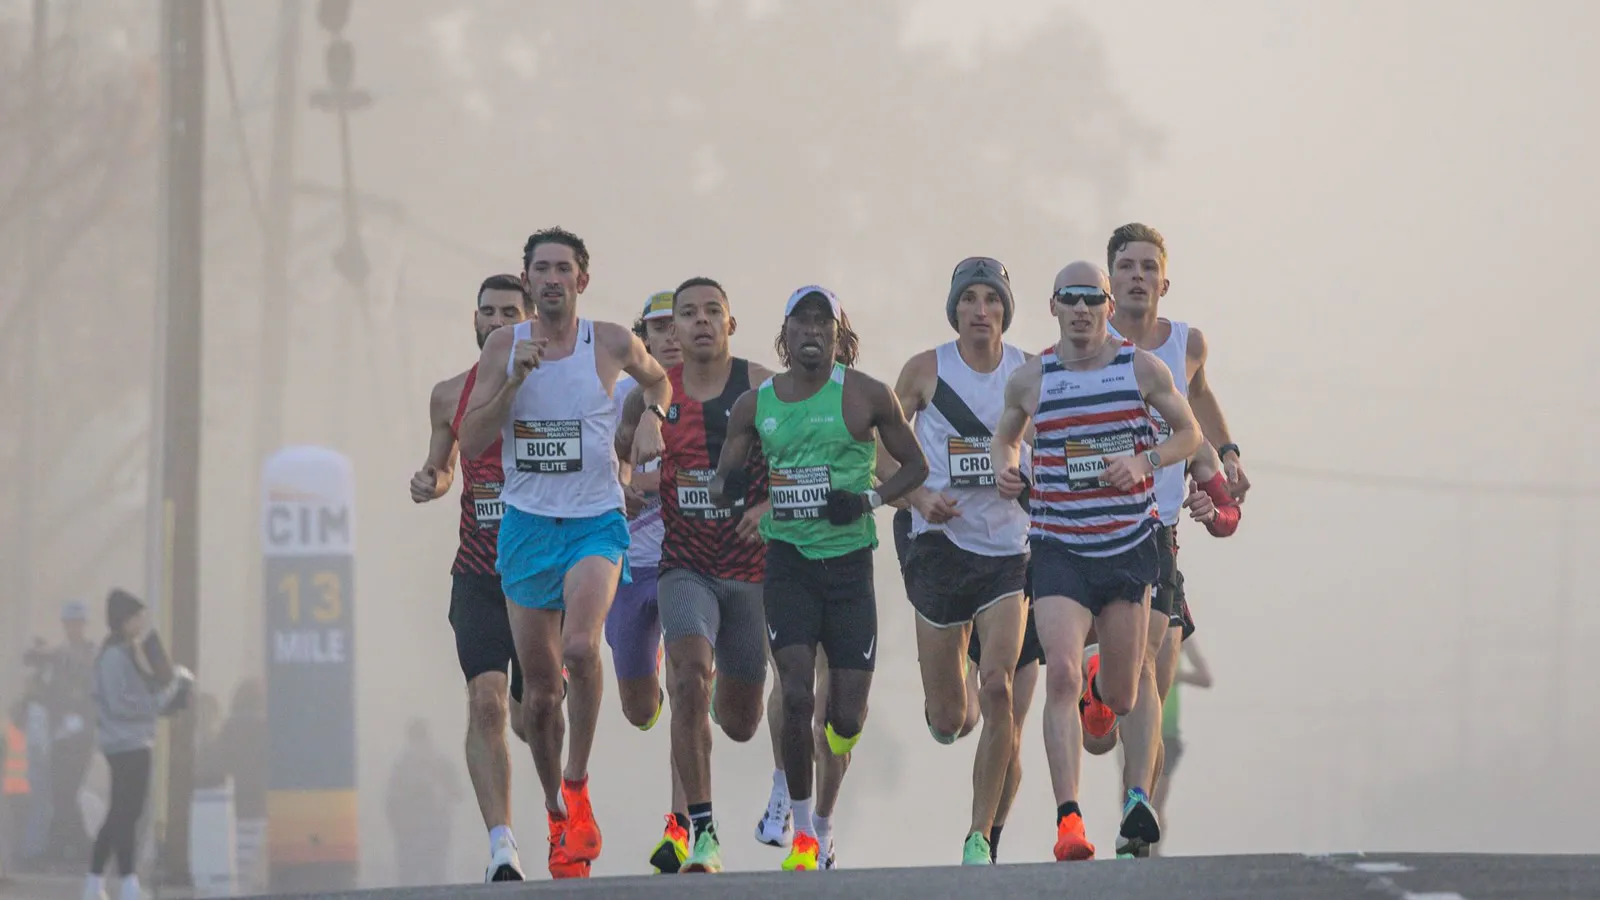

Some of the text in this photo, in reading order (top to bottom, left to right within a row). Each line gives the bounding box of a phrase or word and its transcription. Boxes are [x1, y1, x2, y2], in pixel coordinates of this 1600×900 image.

[1100, 432, 1134, 443] CALIFORNIA
[526, 441, 567, 457] BUCK
[1089, 438, 1133, 449] INTERNATIONAL
[1103, 444, 1134, 454] MARATHON
[540, 462, 568, 471] ELITE
[795, 465, 829, 474] CALIFORNIA
[960, 457, 994, 471] CRO
[797, 477, 829, 485] MARATHON
[681, 490, 712, 505] JOR
[704, 508, 731, 519] ELITE
[793, 508, 819, 519] ELITE
[268, 504, 350, 546] CIM
[279, 572, 342, 624] 13
[273, 628, 346, 664] MILE
